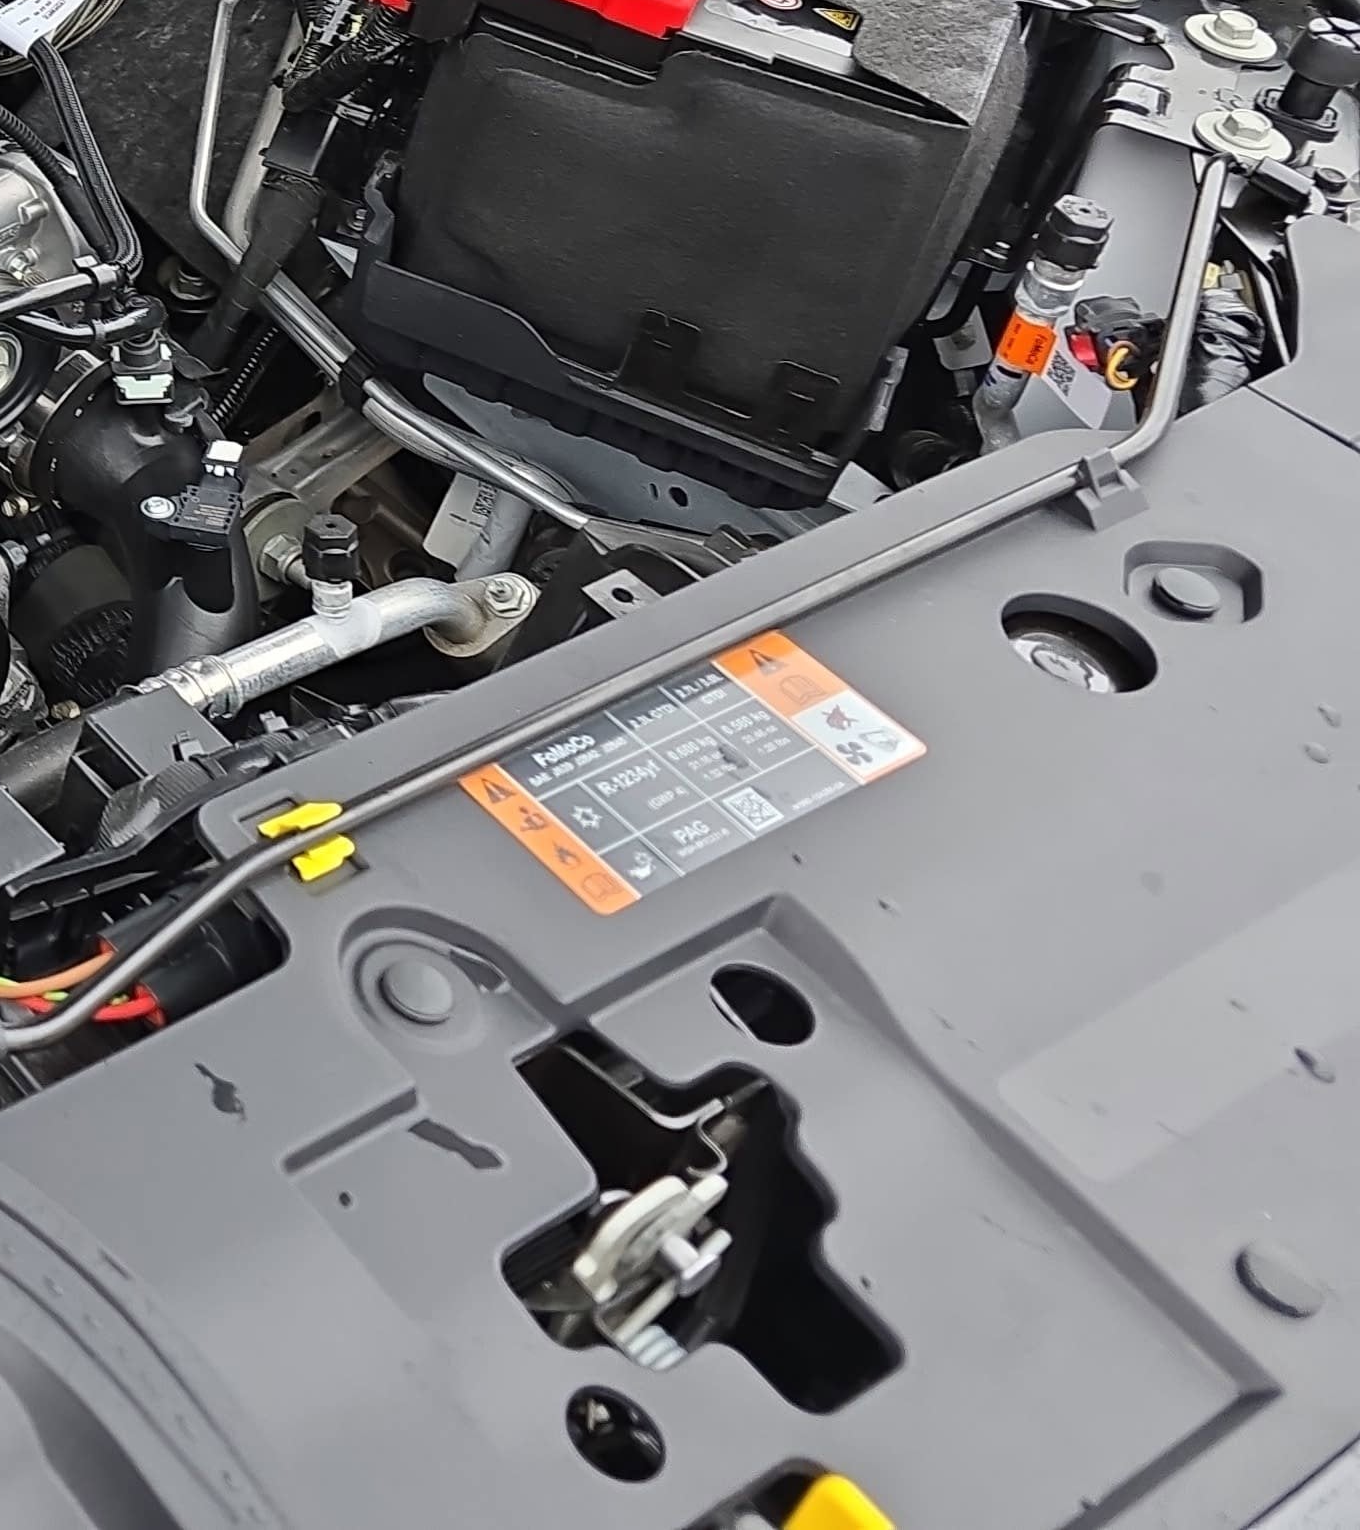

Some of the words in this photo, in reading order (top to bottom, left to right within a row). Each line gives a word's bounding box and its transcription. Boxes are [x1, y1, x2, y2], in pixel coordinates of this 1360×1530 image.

[531, 734, 596, 769] FoMoCo
[595, 758, 662, 797] R-1234yf
[672, 820, 710, 845] PAG
